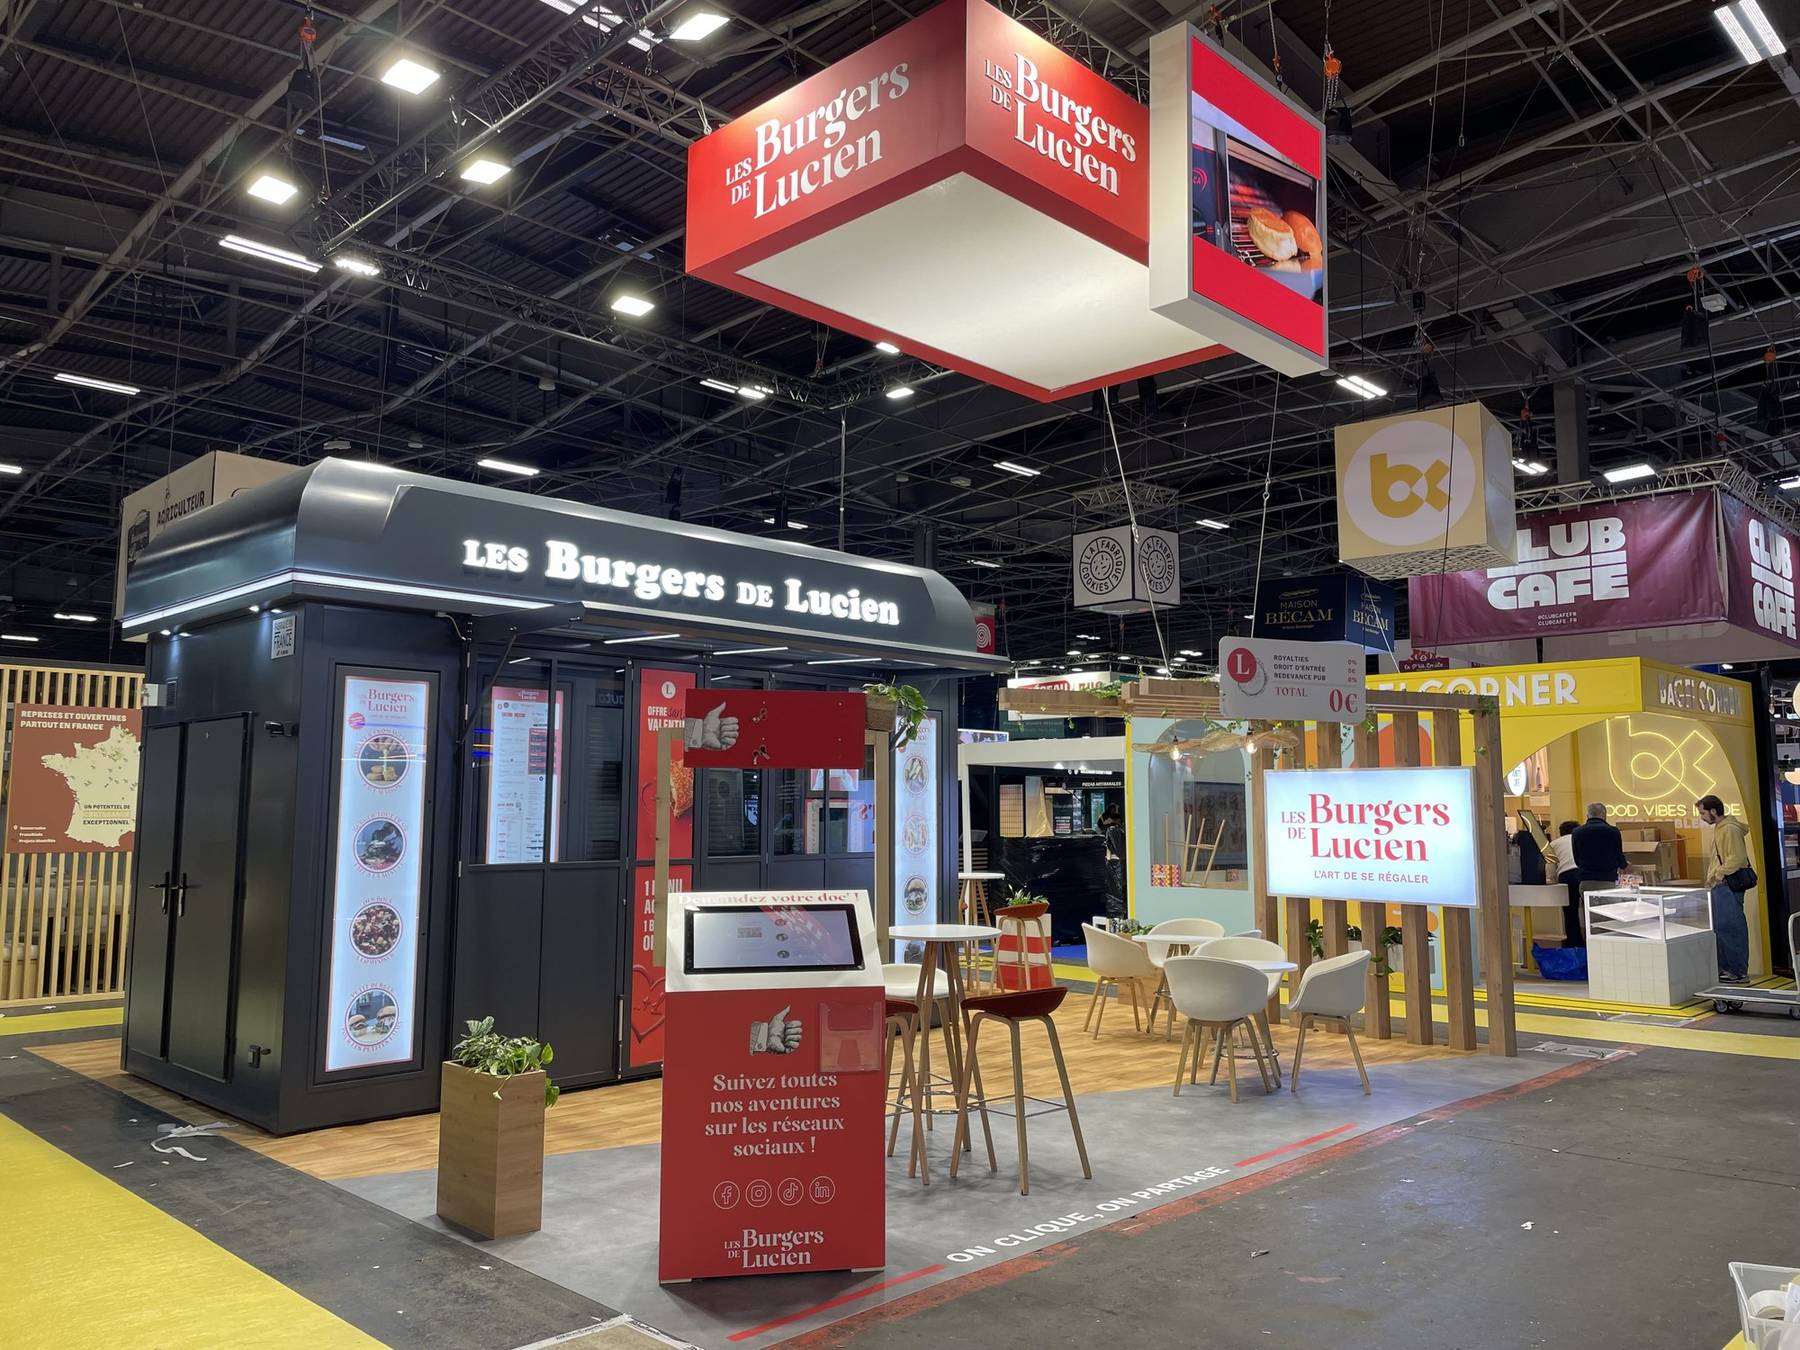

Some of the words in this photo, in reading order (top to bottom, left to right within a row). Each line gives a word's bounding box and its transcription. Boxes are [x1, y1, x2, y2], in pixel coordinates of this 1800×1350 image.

[985, 59, 1012, 89] LES
[1015, 52, 1136, 162] Burgers
[726, 157, 752, 186] LES
[754, 63, 910, 171] Burgers
[991, 85, 1012, 111] DE
[1014, 99, 1119, 196] Lucien
[731, 180, 751, 205] DE
[753, 129, 883, 219] Lucien
[1517, 517, 1626, 563] LUB
[1749, 518, 1793, 580] CLUB
[1085, 546, 1095, 560] LA
[1101, 540, 1123, 581] FABRIQUE
[1143, 542, 1152, 555] LA
[1155, 540, 1173, 584] FABRIQUE
[462, 539, 529, 574] LES
[544, 539, 725, 601] Burgers
[735, 581, 774, 608] DE
[784, 578, 900, 626] Lucien
[1081, 567, 1110, 592] COOKIES
[1280, 600, 1318, 609] MAISON
[1264, 608, 1333, 625] BÉCAM
[1236, 653, 1250, 675] L
[1273, 654, 1309, 662] ROYALTIES
[368, 688, 415, 704] Burgers
[1275, 686, 1308, 697] TOTAL
[21, 710, 63, 719] REPRISES
[75, 712, 127, 722] OUVERTURES
[368, 700, 407, 713] Lucien
[647, 705, 668, 716] OFFRE
[20, 720, 58, 729] PARTOUT
[72, 722, 104, 731] FRANCE
[1281, 811, 1306, 824] LES
[1308, 793, 1451, 836] Burgers
[1605, 804, 1638, 817] OOD
[1643, 803, 1686, 817] VIBES
[1287, 827, 1306, 839] DE
[1310, 827, 1429, 862] Lucien
[1314, 870, 1340, 880] L'ART
[1344, 872, 1357, 880] DE
[1361, 872, 1374, 881] SE
[1378, 870, 1429, 884] RÉGALER
[770, 893, 814, 903] votre
[713, 1073, 776, 1091] Suivez
[780, 1073, 838, 1089] toutes
[710, 1100, 743, 1114] nos
[748, 1095, 840, 1111] aventures
[705, 1123, 737, 1136] sur
[742, 1117, 768, 1134] les
[772, 1115, 845, 1133] réseaux
[733, 1138, 805, 1157] sociaux
[810, 1136, 816, 1153] !
[946, 1245, 994, 1263] ON
[993, 1211, 1104, 1247] CLIQUE,
[1096, 1197, 1138, 1212] ON
[1131, 1166, 1230, 1200] PARTAGE
[724, 1240, 741, 1249] LES
[742, 1228, 825, 1251] Burgers
[728, 1250, 741, 1259] DE
[742, 1249, 811, 1268] Lucien
